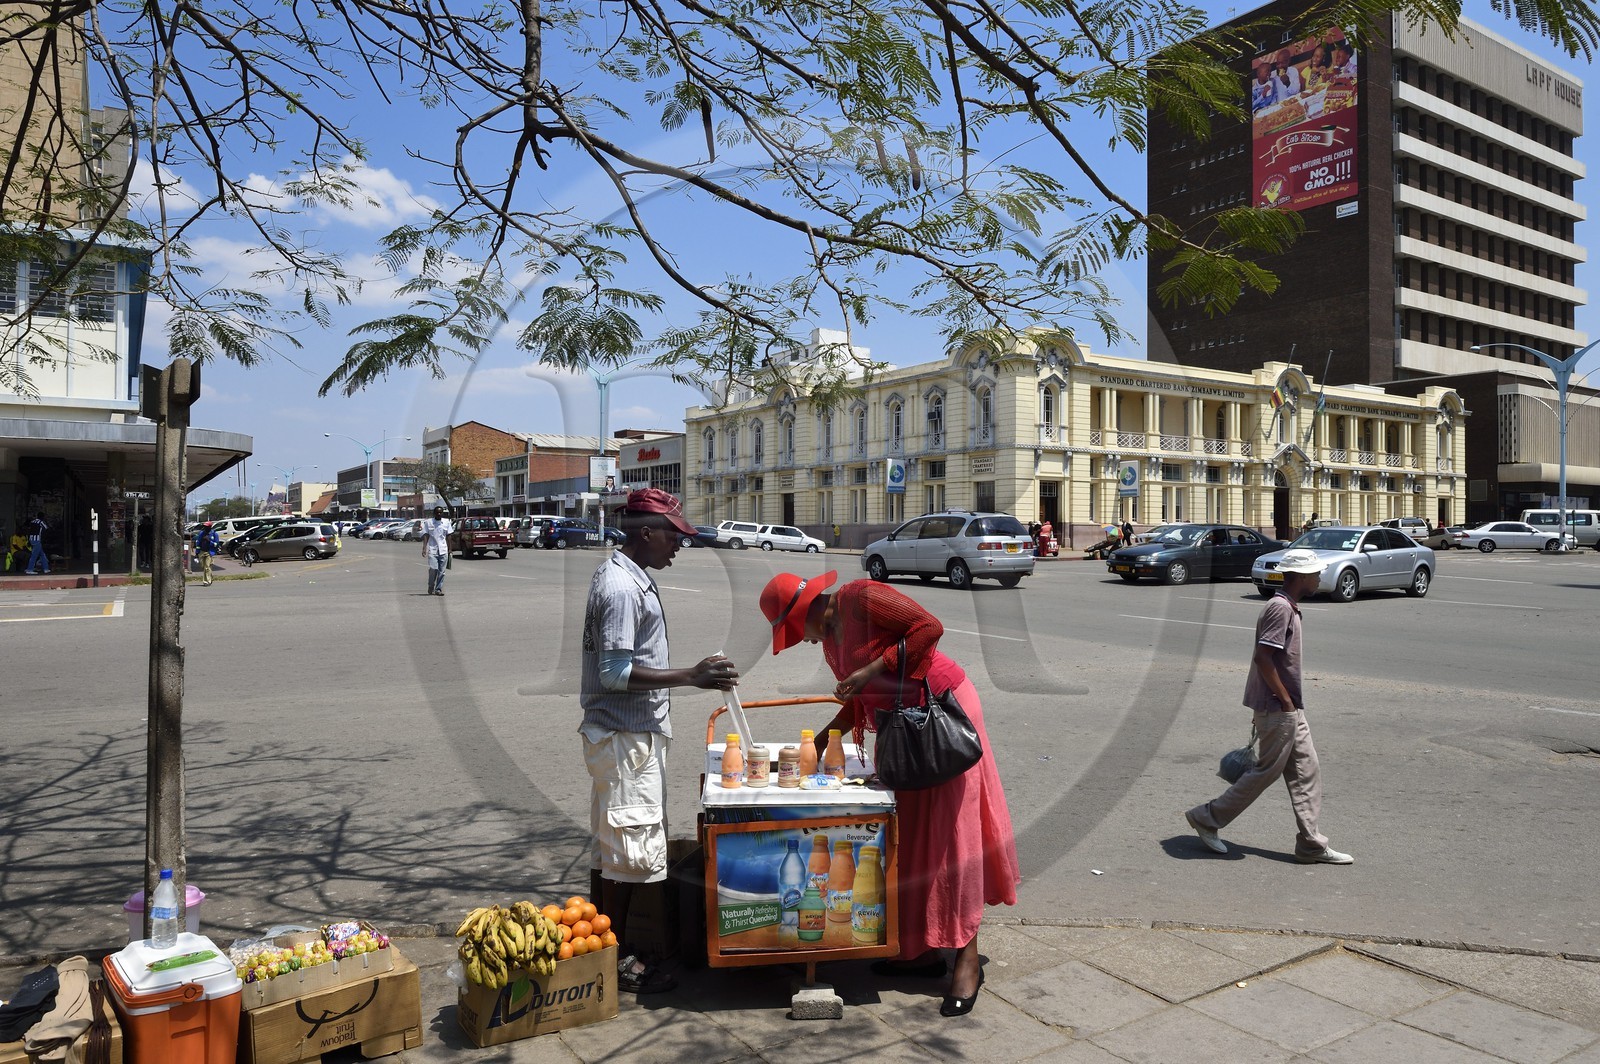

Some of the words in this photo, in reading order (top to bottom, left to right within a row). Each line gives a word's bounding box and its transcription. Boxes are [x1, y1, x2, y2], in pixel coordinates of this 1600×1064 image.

[1526, 63, 1551, 92] LAPF
[1555, 78, 1581, 109] HOUSE
[1302, 157, 1322, 171] NATURAL
[1322, 154, 1333, 164] REAL
[1333, 147, 1354, 160] CHICKEN
[1309, 166, 1329, 180] NO
[1100, 375, 1134, 387] STANDARD
[1135, 379, 1171, 390] CHARTERED
[1173, 383, 1189, 392] BANK
[1191, 386, 1221, 396] ZIMBABWE
[1222, 389, 1245, 399] LIMITED
[846, 834, 876, 842] Beverages
[721, 907, 755, 919] Naturally
[724, 920, 731, 929] &
[731, 918, 749, 928] Thirst
[530, 981, 596, 1010] DUTOIT
[336, 1021, 355, 1034] Fruit
[320, 1031, 358, 1048] Tradouw
